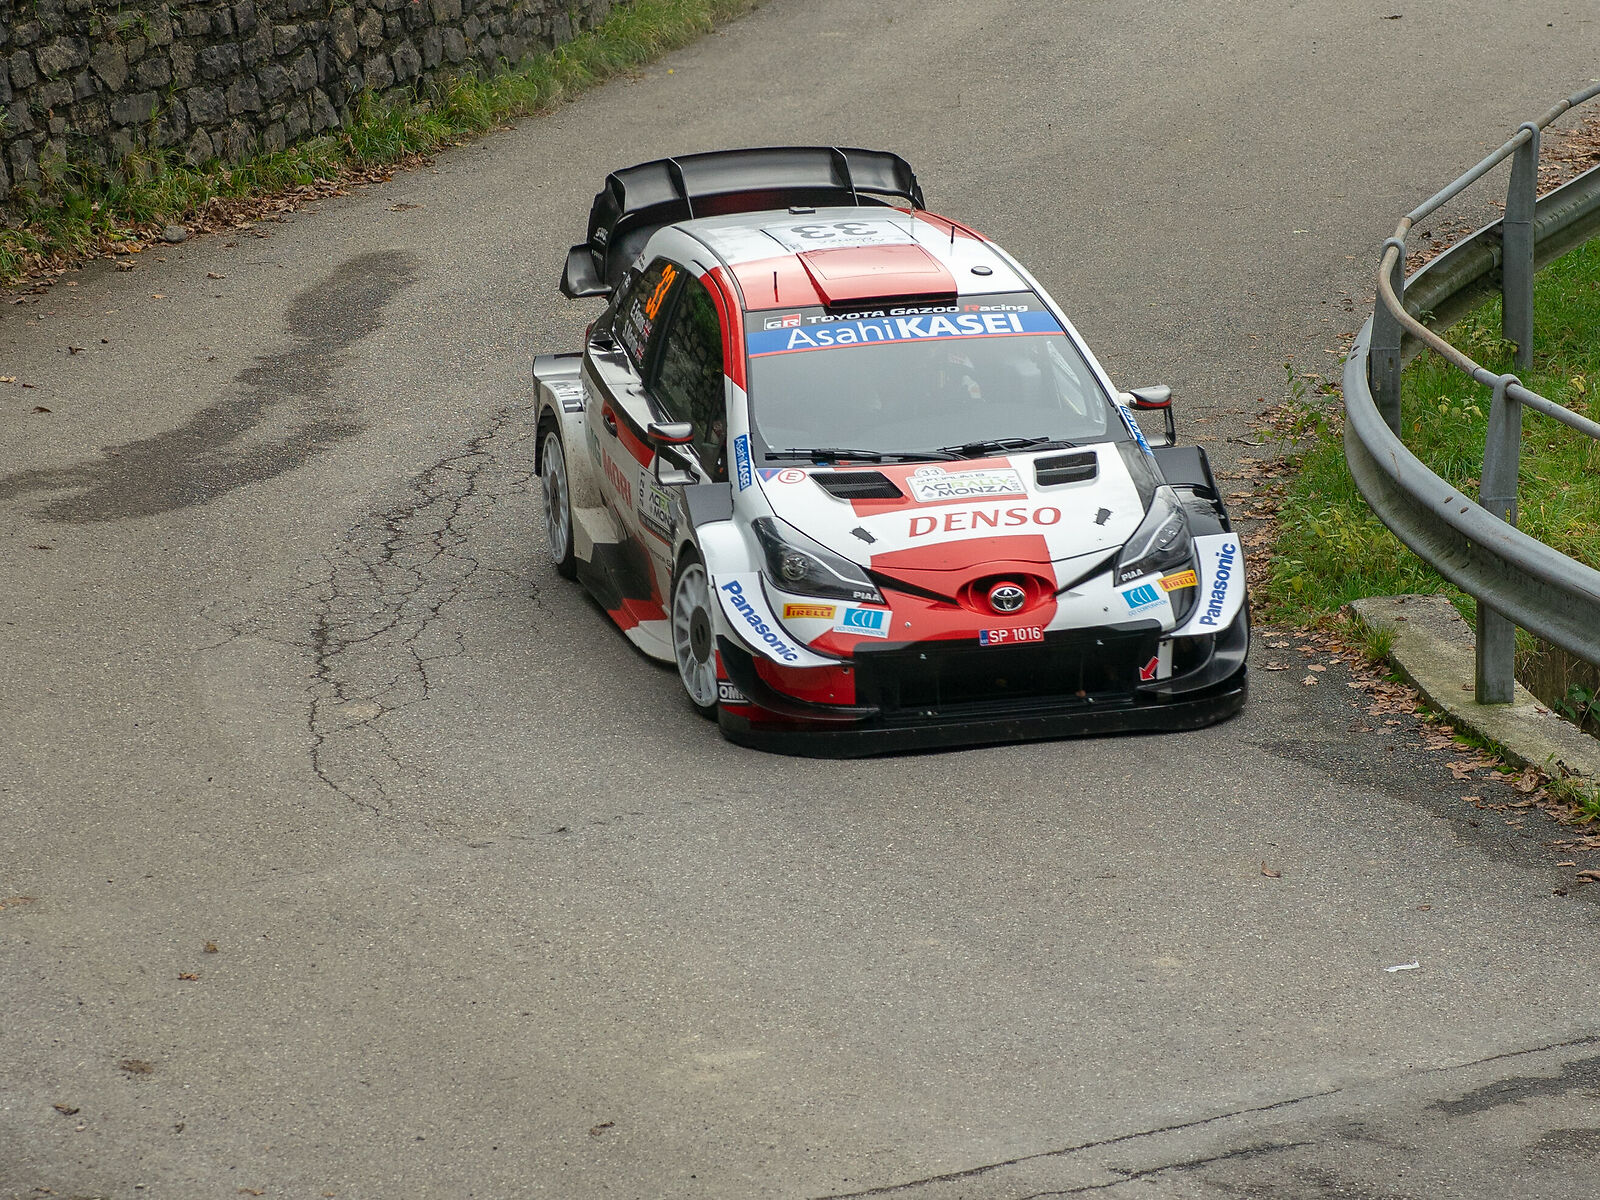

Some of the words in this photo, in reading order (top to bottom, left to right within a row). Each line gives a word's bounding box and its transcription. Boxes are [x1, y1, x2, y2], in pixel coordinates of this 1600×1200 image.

[790, 222, 878, 240] 33
[645, 263, 676, 320] 33
[806, 310, 886, 324] TOYOTA
[890, 305, 960, 316] GAZOO
[963, 303, 1029, 313] Racing
[766, 318, 800, 329] GR
[921, 469, 940, 477] 33
[938, 485, 1013, 497] MONZA
[908, 506, 1063, 538] DENSO
[1121, 568, 1144, 582] PIAA
[1161, 573, 1197, 589] PIRELLI
[1199, 542, 1236, 626] Panasonic
[853, 591, 881, 601] PIAA
[787, 605, 833, 617] PIRELLI
[721, 580, 799, 662] Panasonic
[989, 629, 1009, 643] SP
[1012, 627, 1041, 641] 1016
